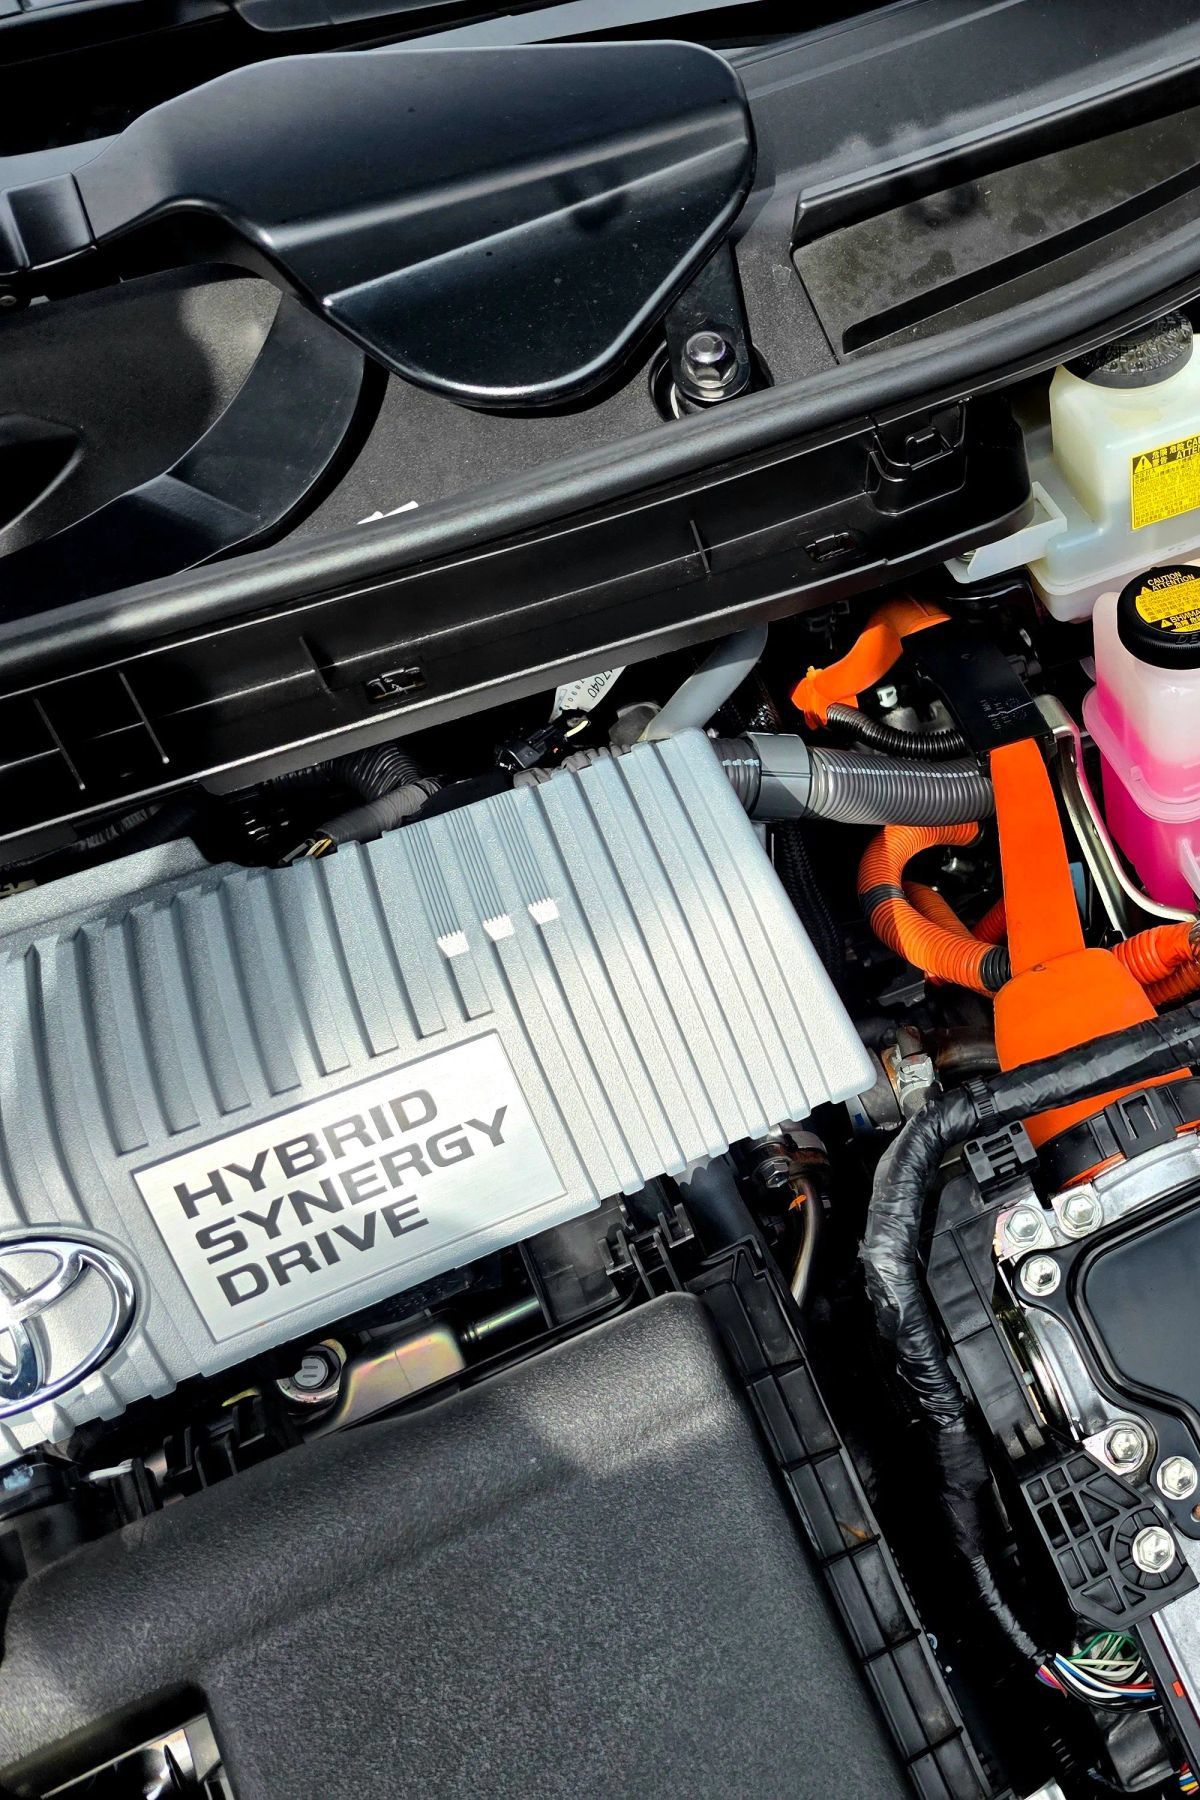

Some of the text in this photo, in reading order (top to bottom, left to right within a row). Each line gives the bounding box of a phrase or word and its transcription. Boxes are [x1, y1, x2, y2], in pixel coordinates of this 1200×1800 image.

[1148, 571, 1182, 585] CAUTION
[1152, 574, 1195, 591] ATTENTION
[588, 671, 612, 698] 7040
[174, 1089, 438, 1220] HYBRID
[195, 1105, 511, 1264] SYNERGY
[216, 1196, 430, 1306] DRIVE
